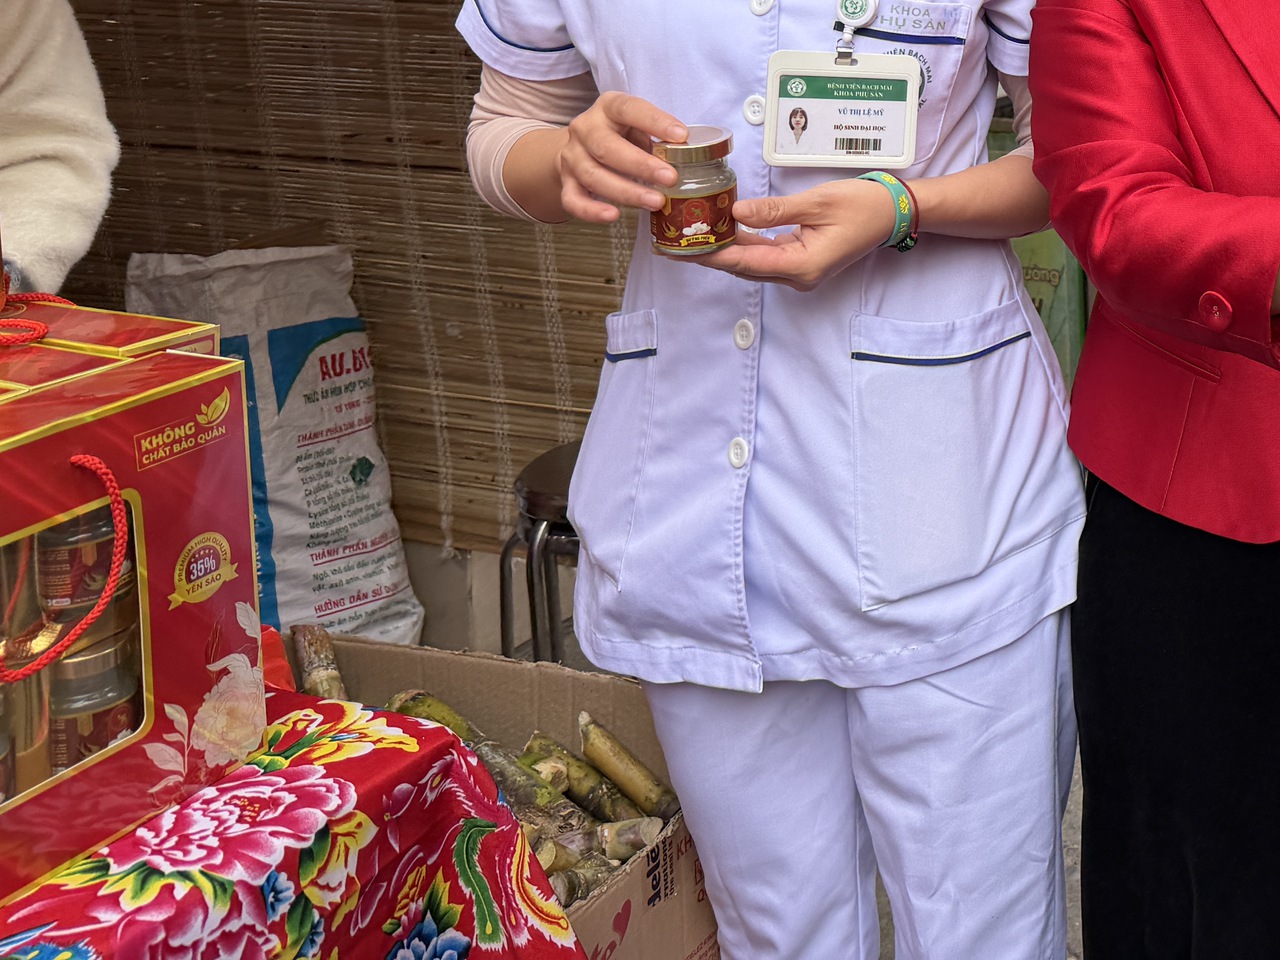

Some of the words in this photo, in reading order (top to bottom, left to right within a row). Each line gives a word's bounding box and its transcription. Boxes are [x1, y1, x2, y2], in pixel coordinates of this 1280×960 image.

[880, 15, 906, 29] HỤ
[890, 5, 931, 18] KHOA
[925, 66, 933, 84] MAI
[141, 422, 195, 452] KHÔNG
[142, 444, 171, 464] CHẤT
[173, 437, 195, 453] BẢO
[197, 425, 226, 444] QUẢN
[178, 546, 194, 582] PREMIUM
[195, 536, 212, 547] HIGH
[212, 537, 227, 561] QUALITY
[310, 547, 339, 561] THÀNH
[190, 555, 216, 580] 35%
